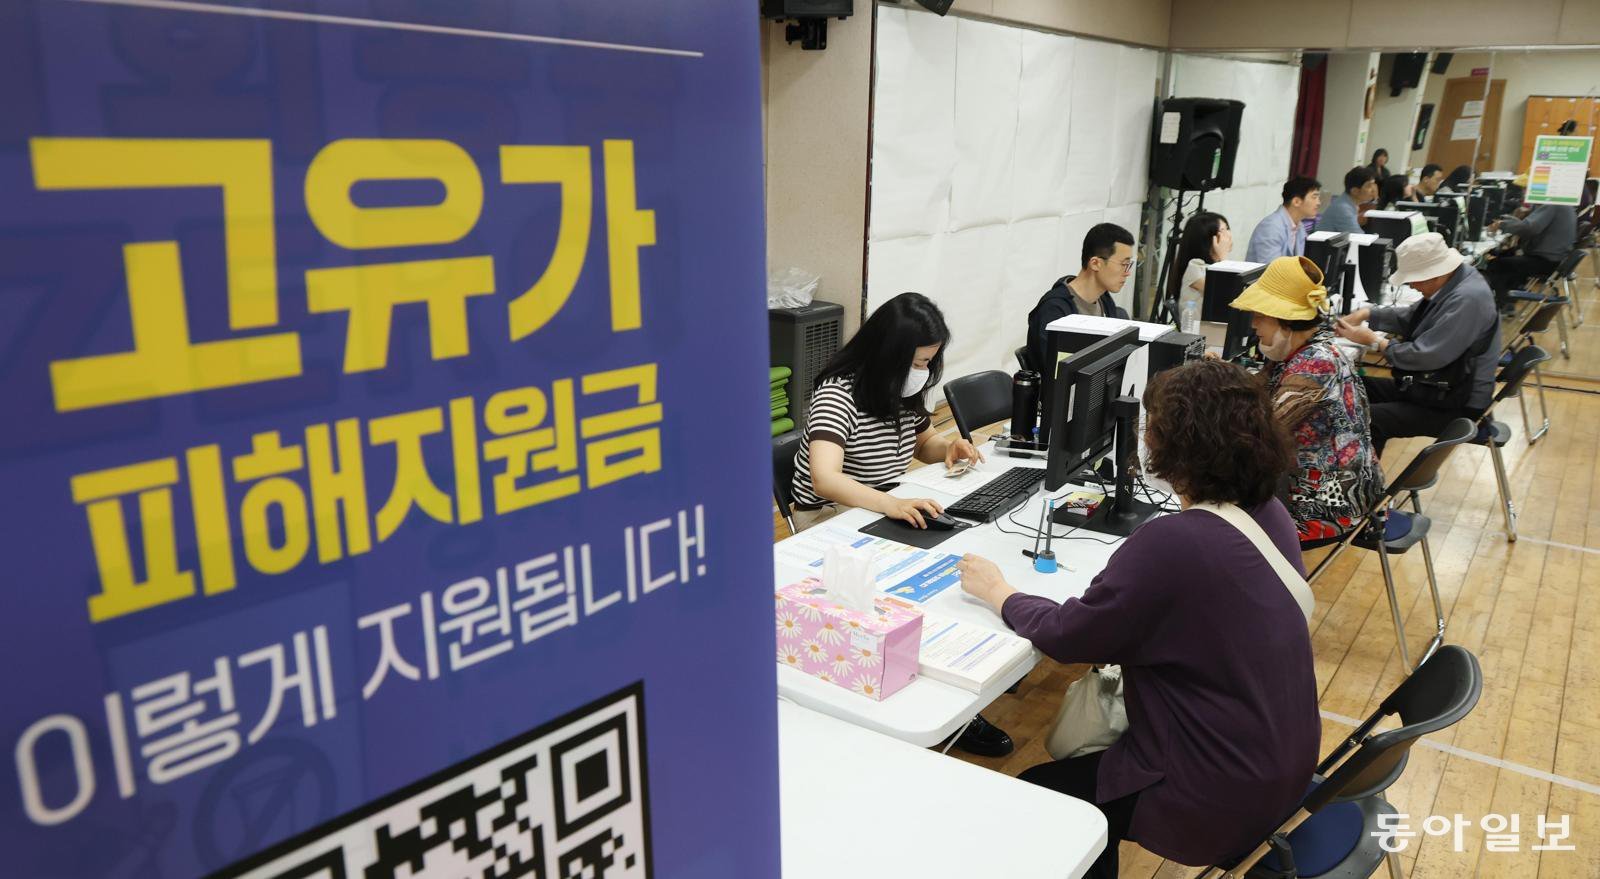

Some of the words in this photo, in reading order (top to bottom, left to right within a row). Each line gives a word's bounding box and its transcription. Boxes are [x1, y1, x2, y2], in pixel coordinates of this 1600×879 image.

[29, 136, 657, 413] 고유가
[70, 362, 664, 624] 피해지원금
[14, 624, 338, 827] 이렇게
[358, 504, 708, 702] 지원됩니다!
